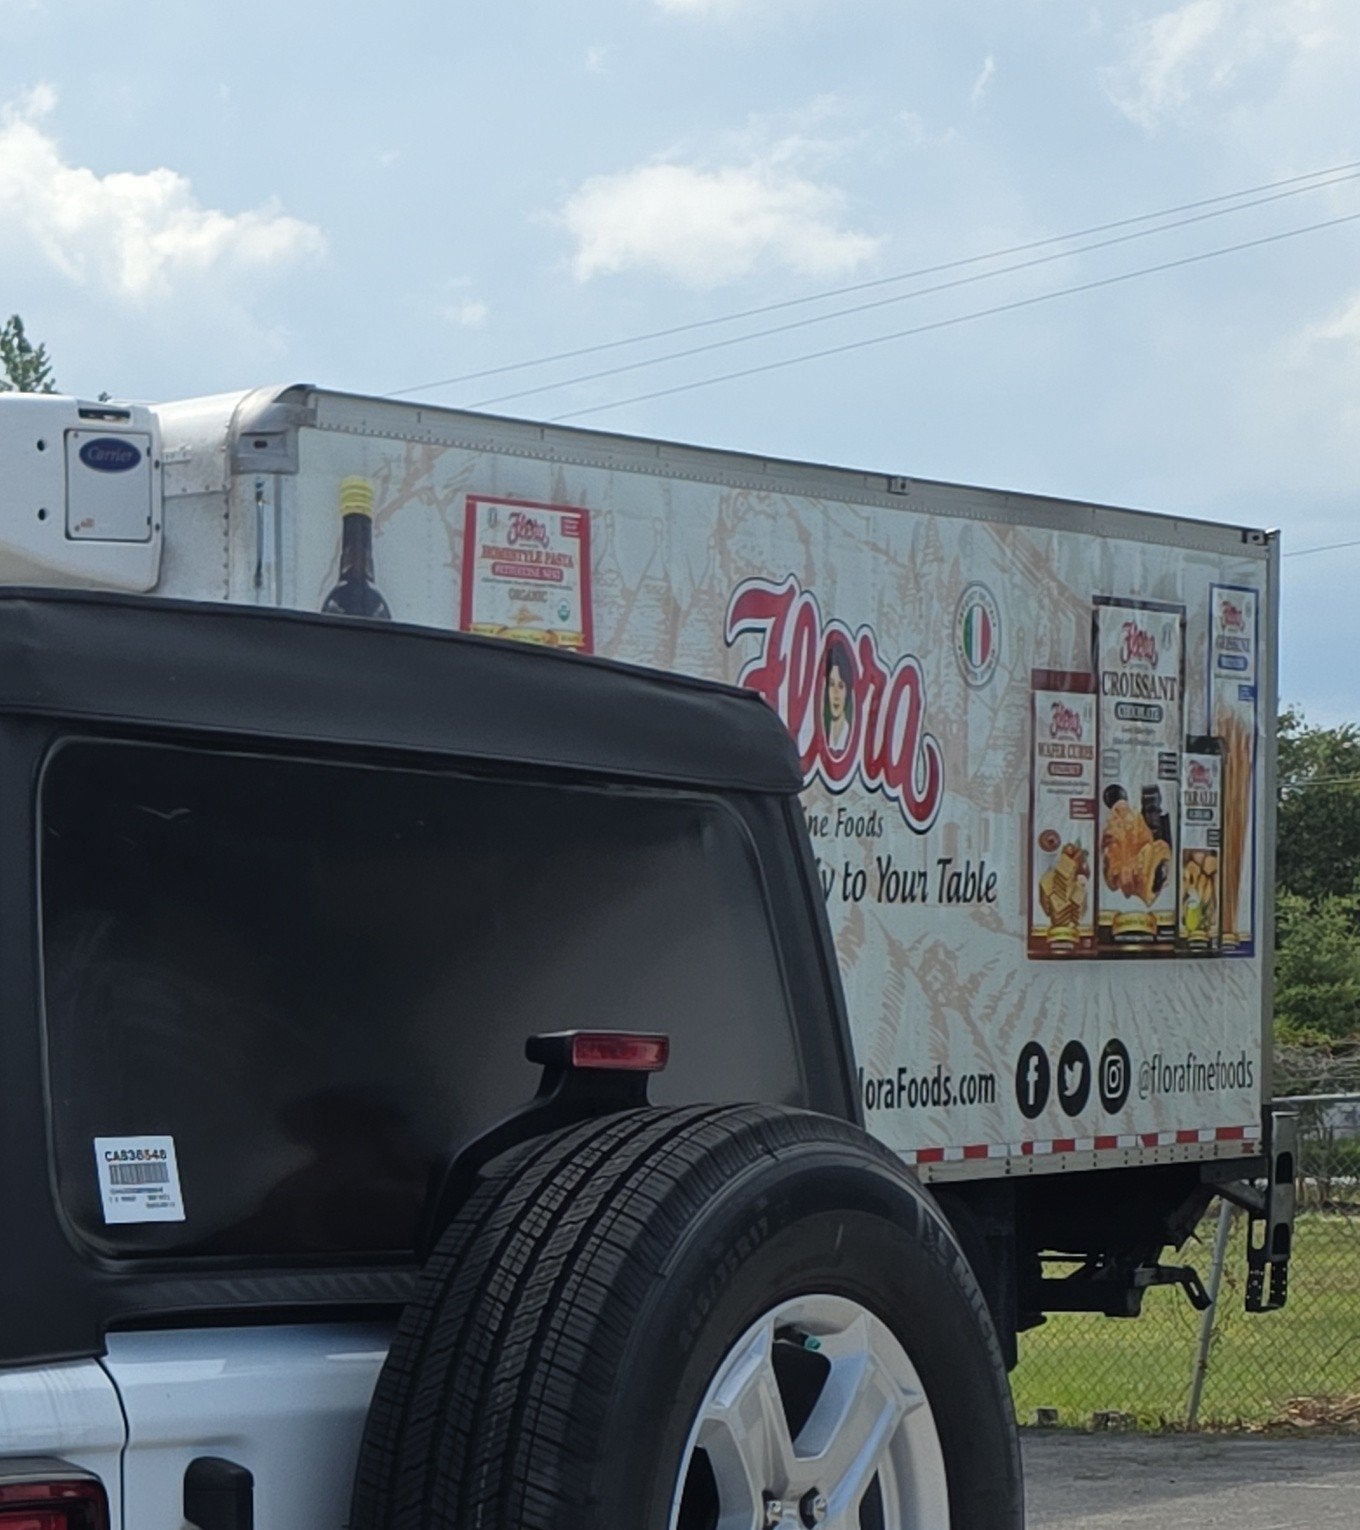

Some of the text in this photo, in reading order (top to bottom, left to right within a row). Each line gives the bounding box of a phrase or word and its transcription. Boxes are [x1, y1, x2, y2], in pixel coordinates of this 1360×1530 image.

[87, 446, 134, 464] Carrier
[725, 573, 944, 835] Flora
[1102, 671, 1177, 701] CROISSANT
[835, 807, 884, 838] Foods
[843, 859, 867, 902] to
[876, 854, 928, 903] Your
[936, 857, 997, 904] Table
[858, 1064, 996, 1111] loraFoods.com
[1138, 1050, 1254, 1100] @florafinefoods
